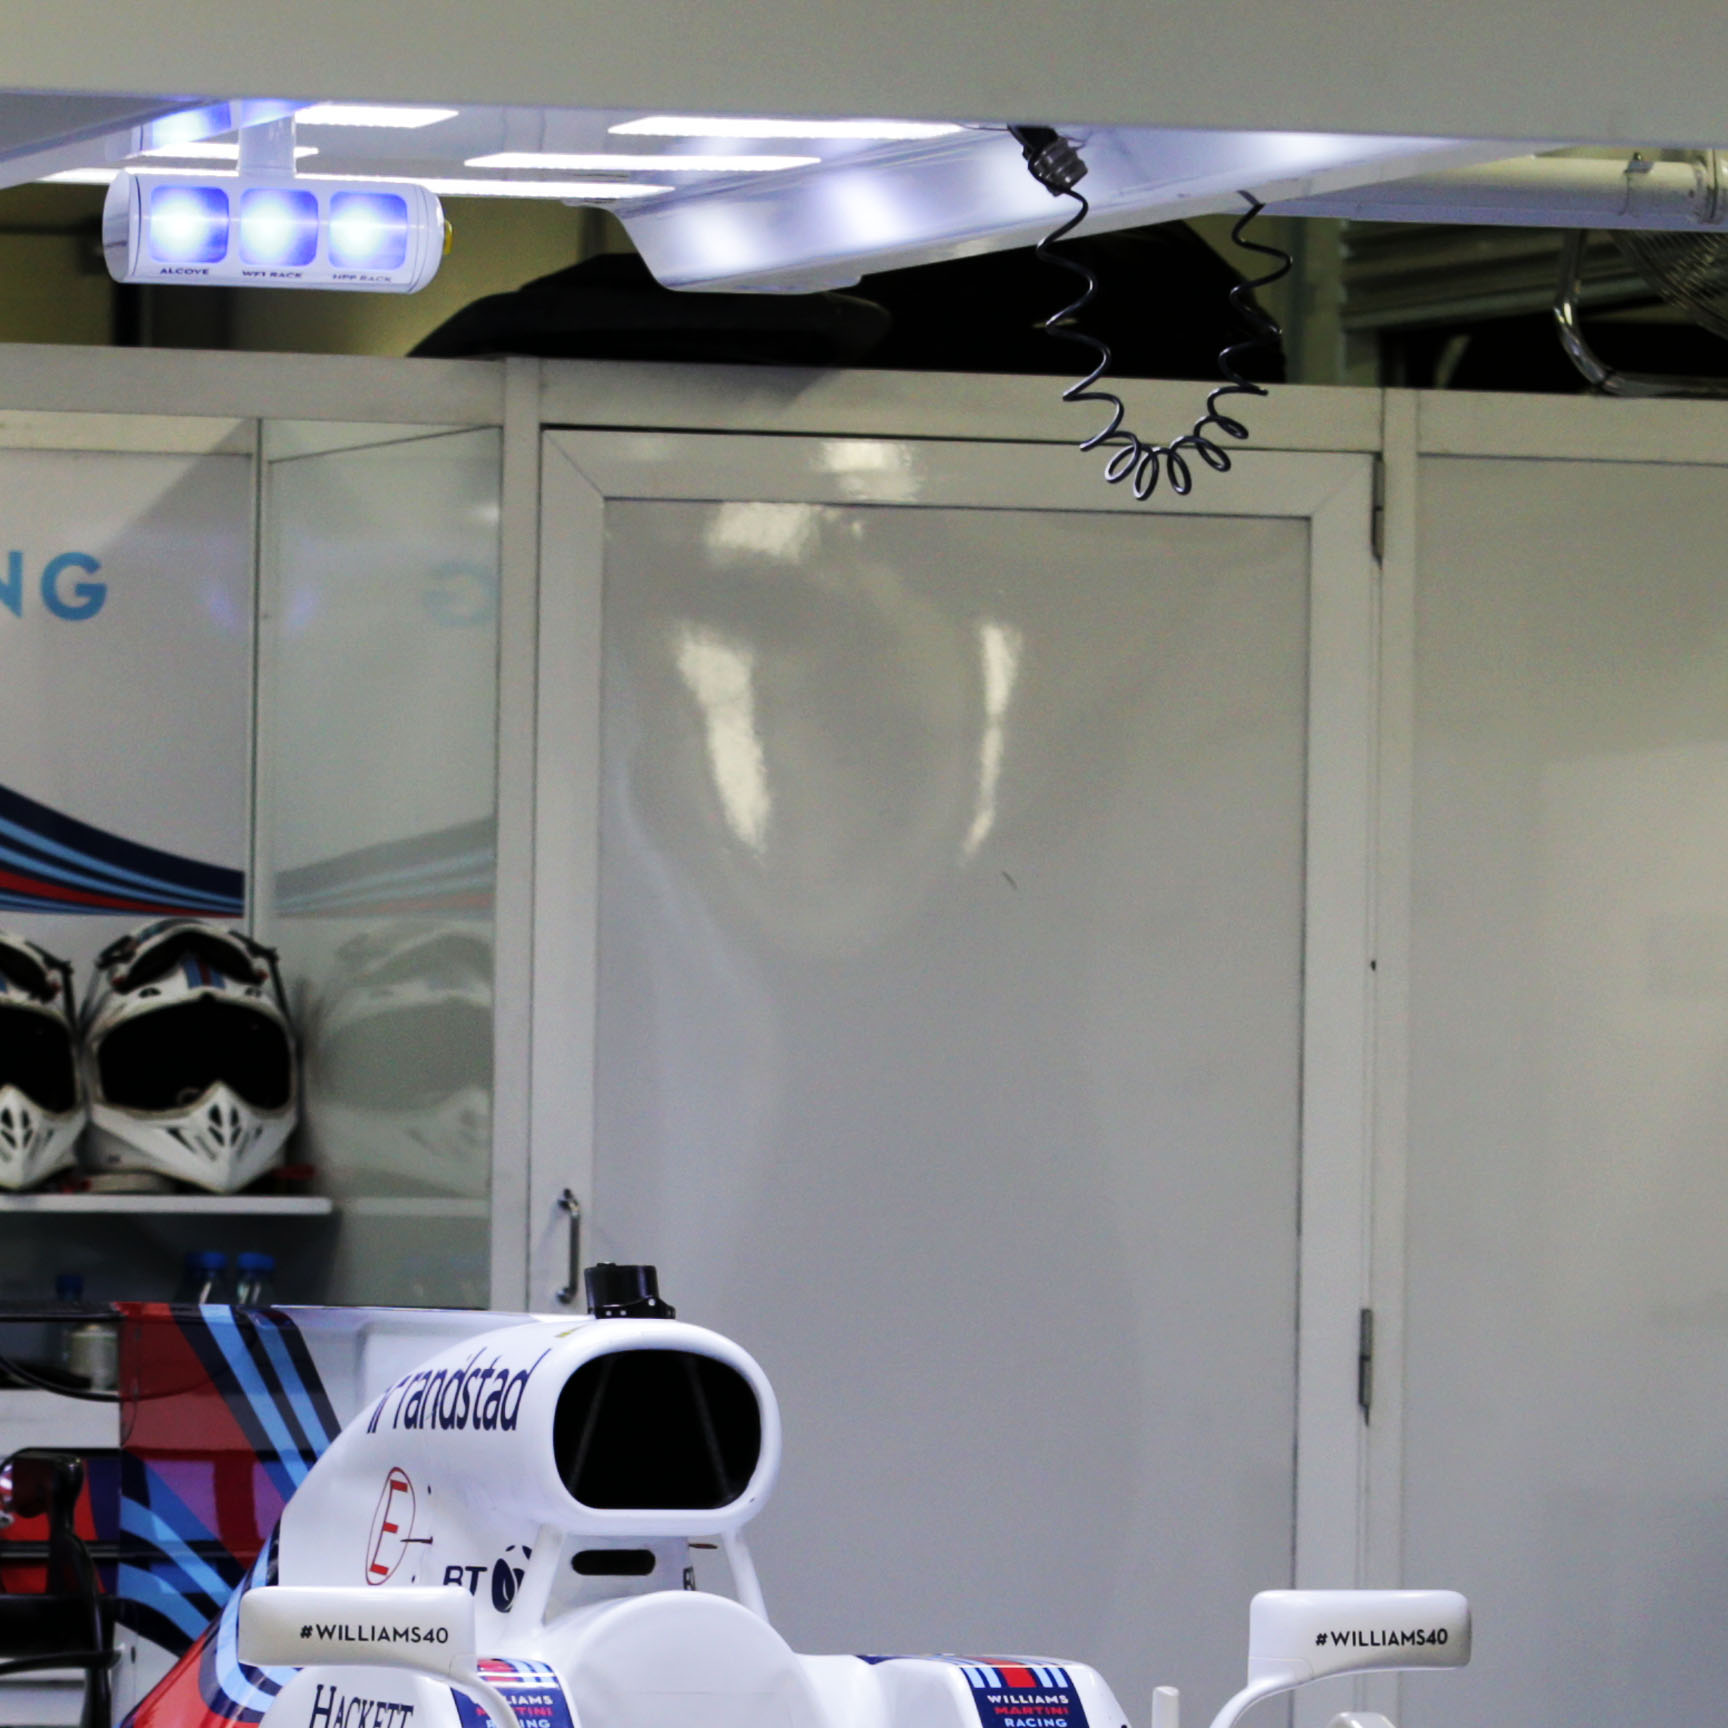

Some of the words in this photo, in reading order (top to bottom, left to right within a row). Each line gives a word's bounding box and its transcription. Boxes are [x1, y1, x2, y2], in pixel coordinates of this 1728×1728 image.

[160, 267, 210, 276] ALCOVE
[392, 1346, 552, 1431] randstad
[299, 1625, 450, 1645] #WILLIAMS40
[1315, 1627, 1449, 1648] #WILLIAMS40
[505, 1695, 553, 1705] LIAMS
[987, 1694, 1070, 1704] WILLIAMS
[994, 1706, 1070, 1715] MARTINI
[1004, 1717, 1068, 1728] RACING
